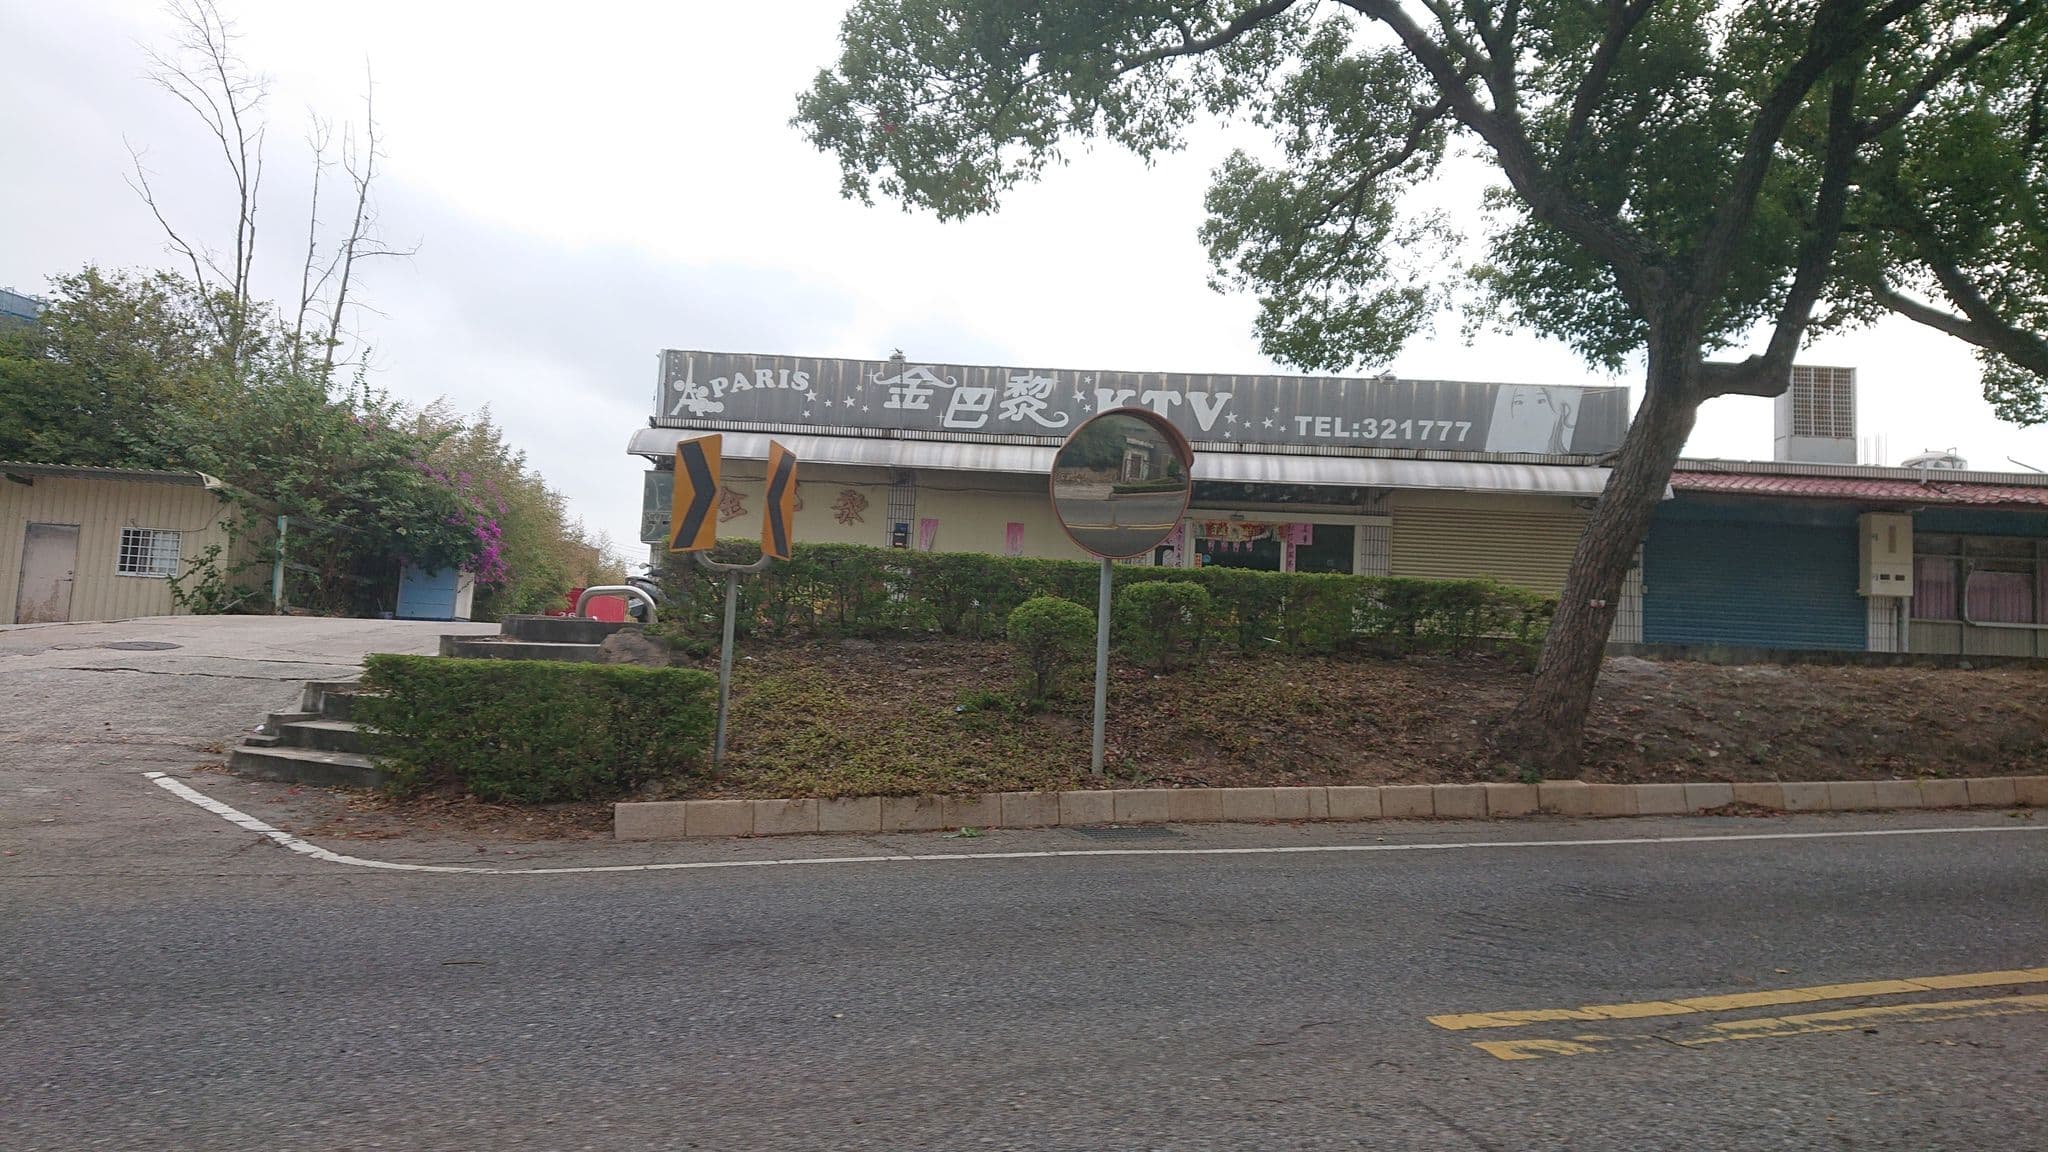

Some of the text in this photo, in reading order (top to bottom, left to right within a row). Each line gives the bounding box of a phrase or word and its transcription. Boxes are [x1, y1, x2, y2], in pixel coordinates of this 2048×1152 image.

[709, 368, 810, 398] PARIS
[872, 366, 1233, 432] 金巴黎 KTV
[1294, 415, 1473, 442] TEL:321777
